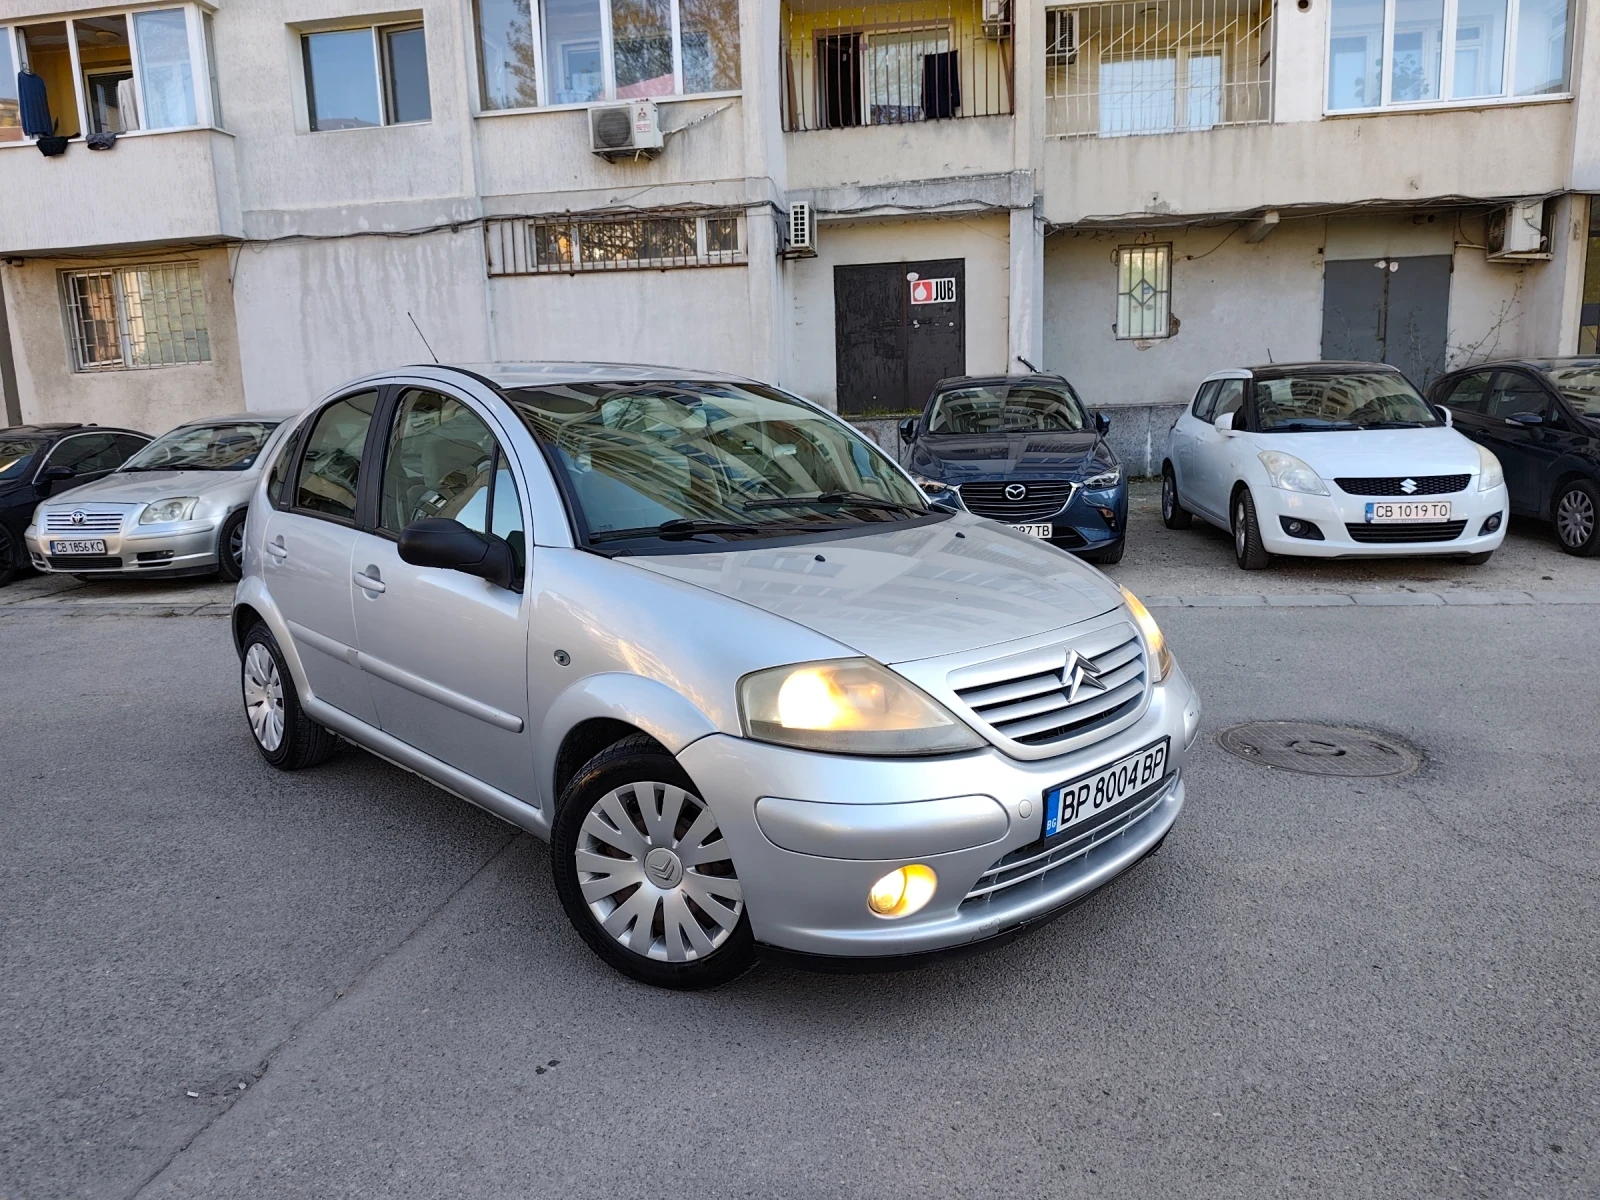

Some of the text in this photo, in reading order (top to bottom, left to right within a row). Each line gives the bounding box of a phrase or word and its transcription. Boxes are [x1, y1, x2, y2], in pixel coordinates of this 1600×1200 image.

[934, 280, 954, 301] JUB
[1376, 504, 1447, 517] CB 1019 TO
[1035, 525, 1050, 536] TB
[56, 541, 103, 552] CB 1856 KC
[1061, 747, 1164, 825] BP 8004 BP
[1046, 818, 1057, 830] BG
